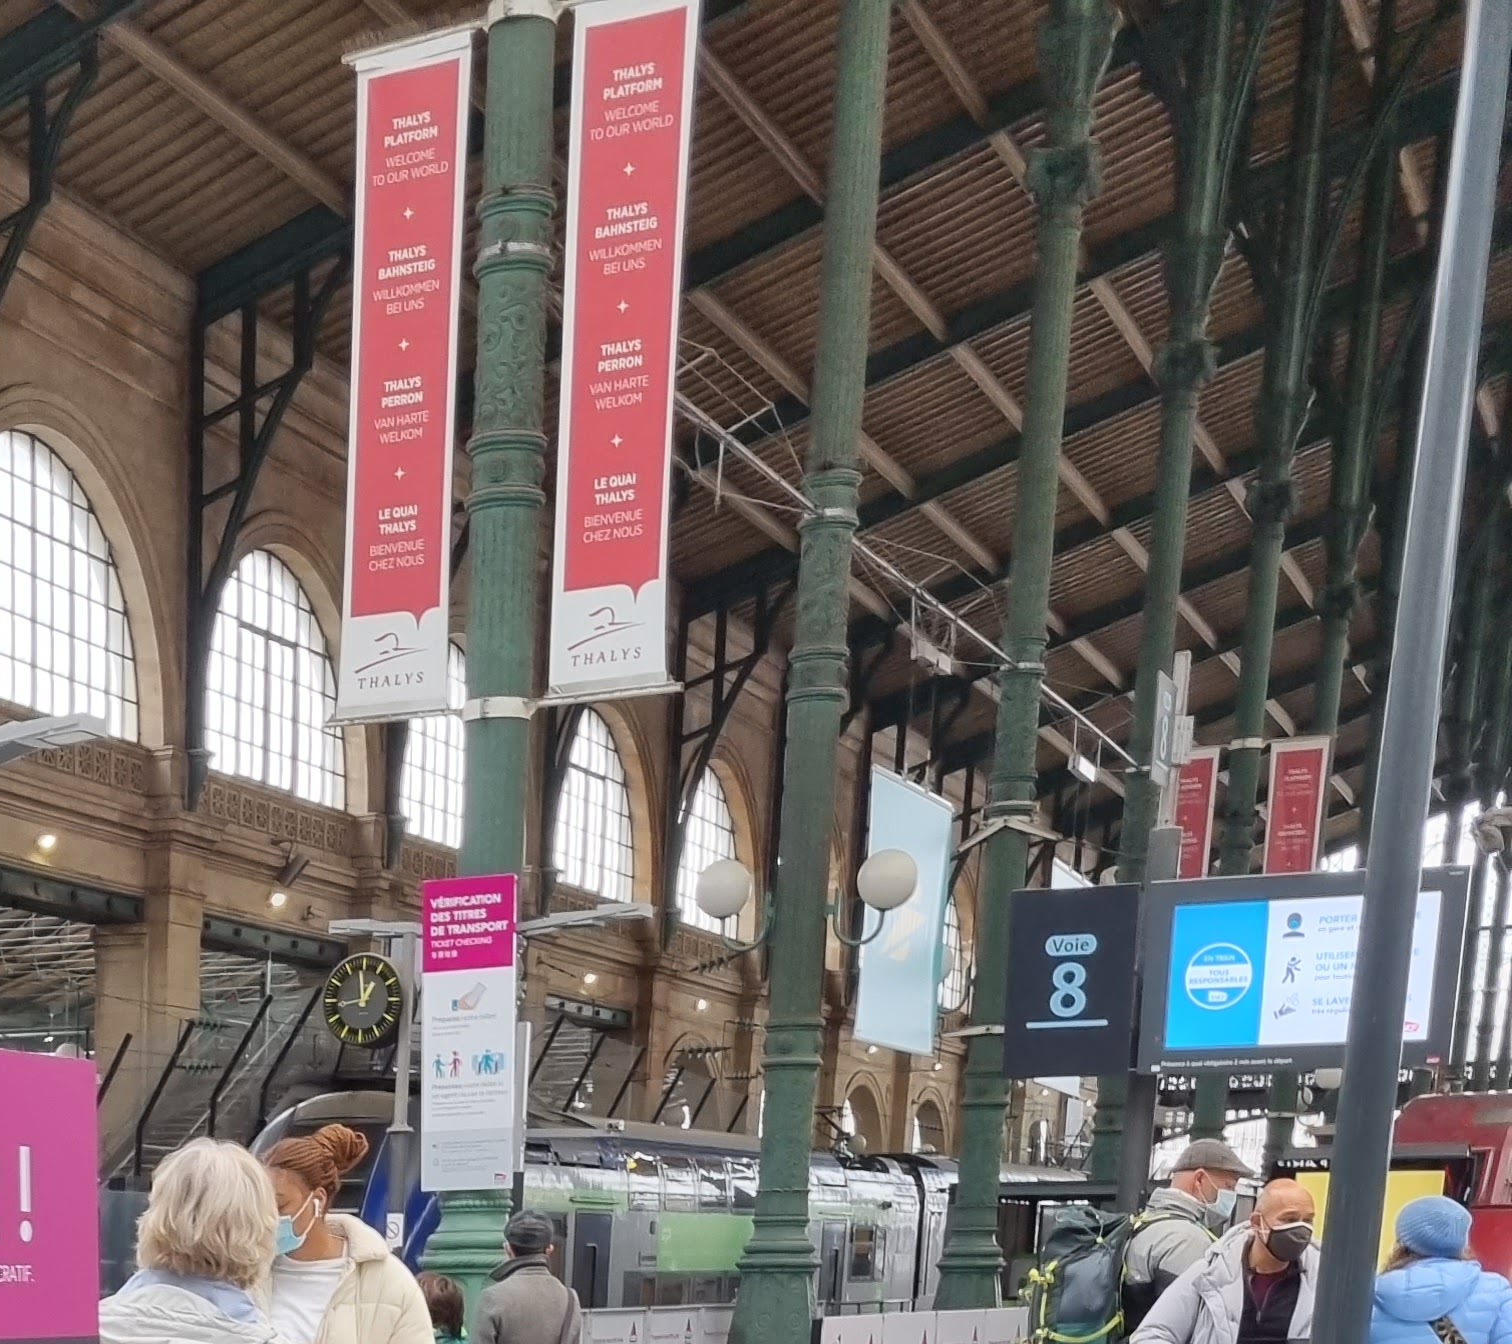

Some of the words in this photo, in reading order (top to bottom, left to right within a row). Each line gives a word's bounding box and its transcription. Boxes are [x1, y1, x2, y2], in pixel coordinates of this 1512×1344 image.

[613, 62, 655, 82] THALYS
[603, 78, 662, 100] PLATFORM
[604, 100, 659, 122] WELCOME
[392, 111, 431, 130] THALYS
[590, 127, 603, 141] TO
[606, 122, 629, 138] OUR
[632, 114, 674, 133] WORLD
[384, 126, 438, 148] PLATFORM
[385, 148, 436, 168] WELCOME
[372, 175, 385, 187] TO
[387, 170, 408, 184] OUR
[411, 161, 448, 179] WORLD
[606, 202, 648, 220] THALYS
[595, 217, 657, 239] BAHNSTEIG
[388, 245, 427, 262] THALYS
[589, 238, 662, 261] WILLKOMMEN
[378, 259, 436, 280] BAHNSTEIG
[604, 261, 620, 275] BEI
[623, 257, 646, 272] UNS
[373, 280, 440, 301] WILLKOMMEN
[387, 302, 402, 315] BEI
[404, 298, 424, 312] UNS
[601, 339, 641, 356] THALYS
[598, 355, 643, 373] PERRON
[384, 376, 422, 392] THALYS
[589, 381, 611, 395] VAN
[614, 374, 649, 391] HARTE
[381, 391, 423, 408] PERRON
[595, 393, 642, 410] WELKOM
[374, 416, 394, 430] VAN
[397, 410, 429, 425] HARTE
[380, 427, 423, 444] WELKOM
[594, 478, 607, 490] LE
[609, 473, 636, 487] QUAI
[595, 489, 635, 505] THALYS
[379, 508, 390, 520] LE
[393, 504, 417, 518] QUAI
[584, 509, 643, 528] BIENVENUE
[379, 520, 416, 535] THALYS
[583, 530, 611, 544] CHEZ
[613, 524, 643, 540] NOUS
[370, 539, 424, 557] BIENVENUE
[369, 559, 394, 571] CHEZ
[397, 554, 424, 568] NOUS
[570, 645, 644, 668] THALYS
[357, 671, 425, 691] THALYS
[430, 893, 501, 909] VÉRIFICATION
[430, 912, 451, 922] DES
[453, 908, 487, 920] TITRES
[1319, 914, 1357, 924] PORTER
[431, 926, 444, 936] DE
[447, 920, 508, 935] TRANSPORT
[1051, 937, 1090, 953] Voie
[1049, 961, 1087, 1019] 8
[19, 1145, 33, 1243] !
